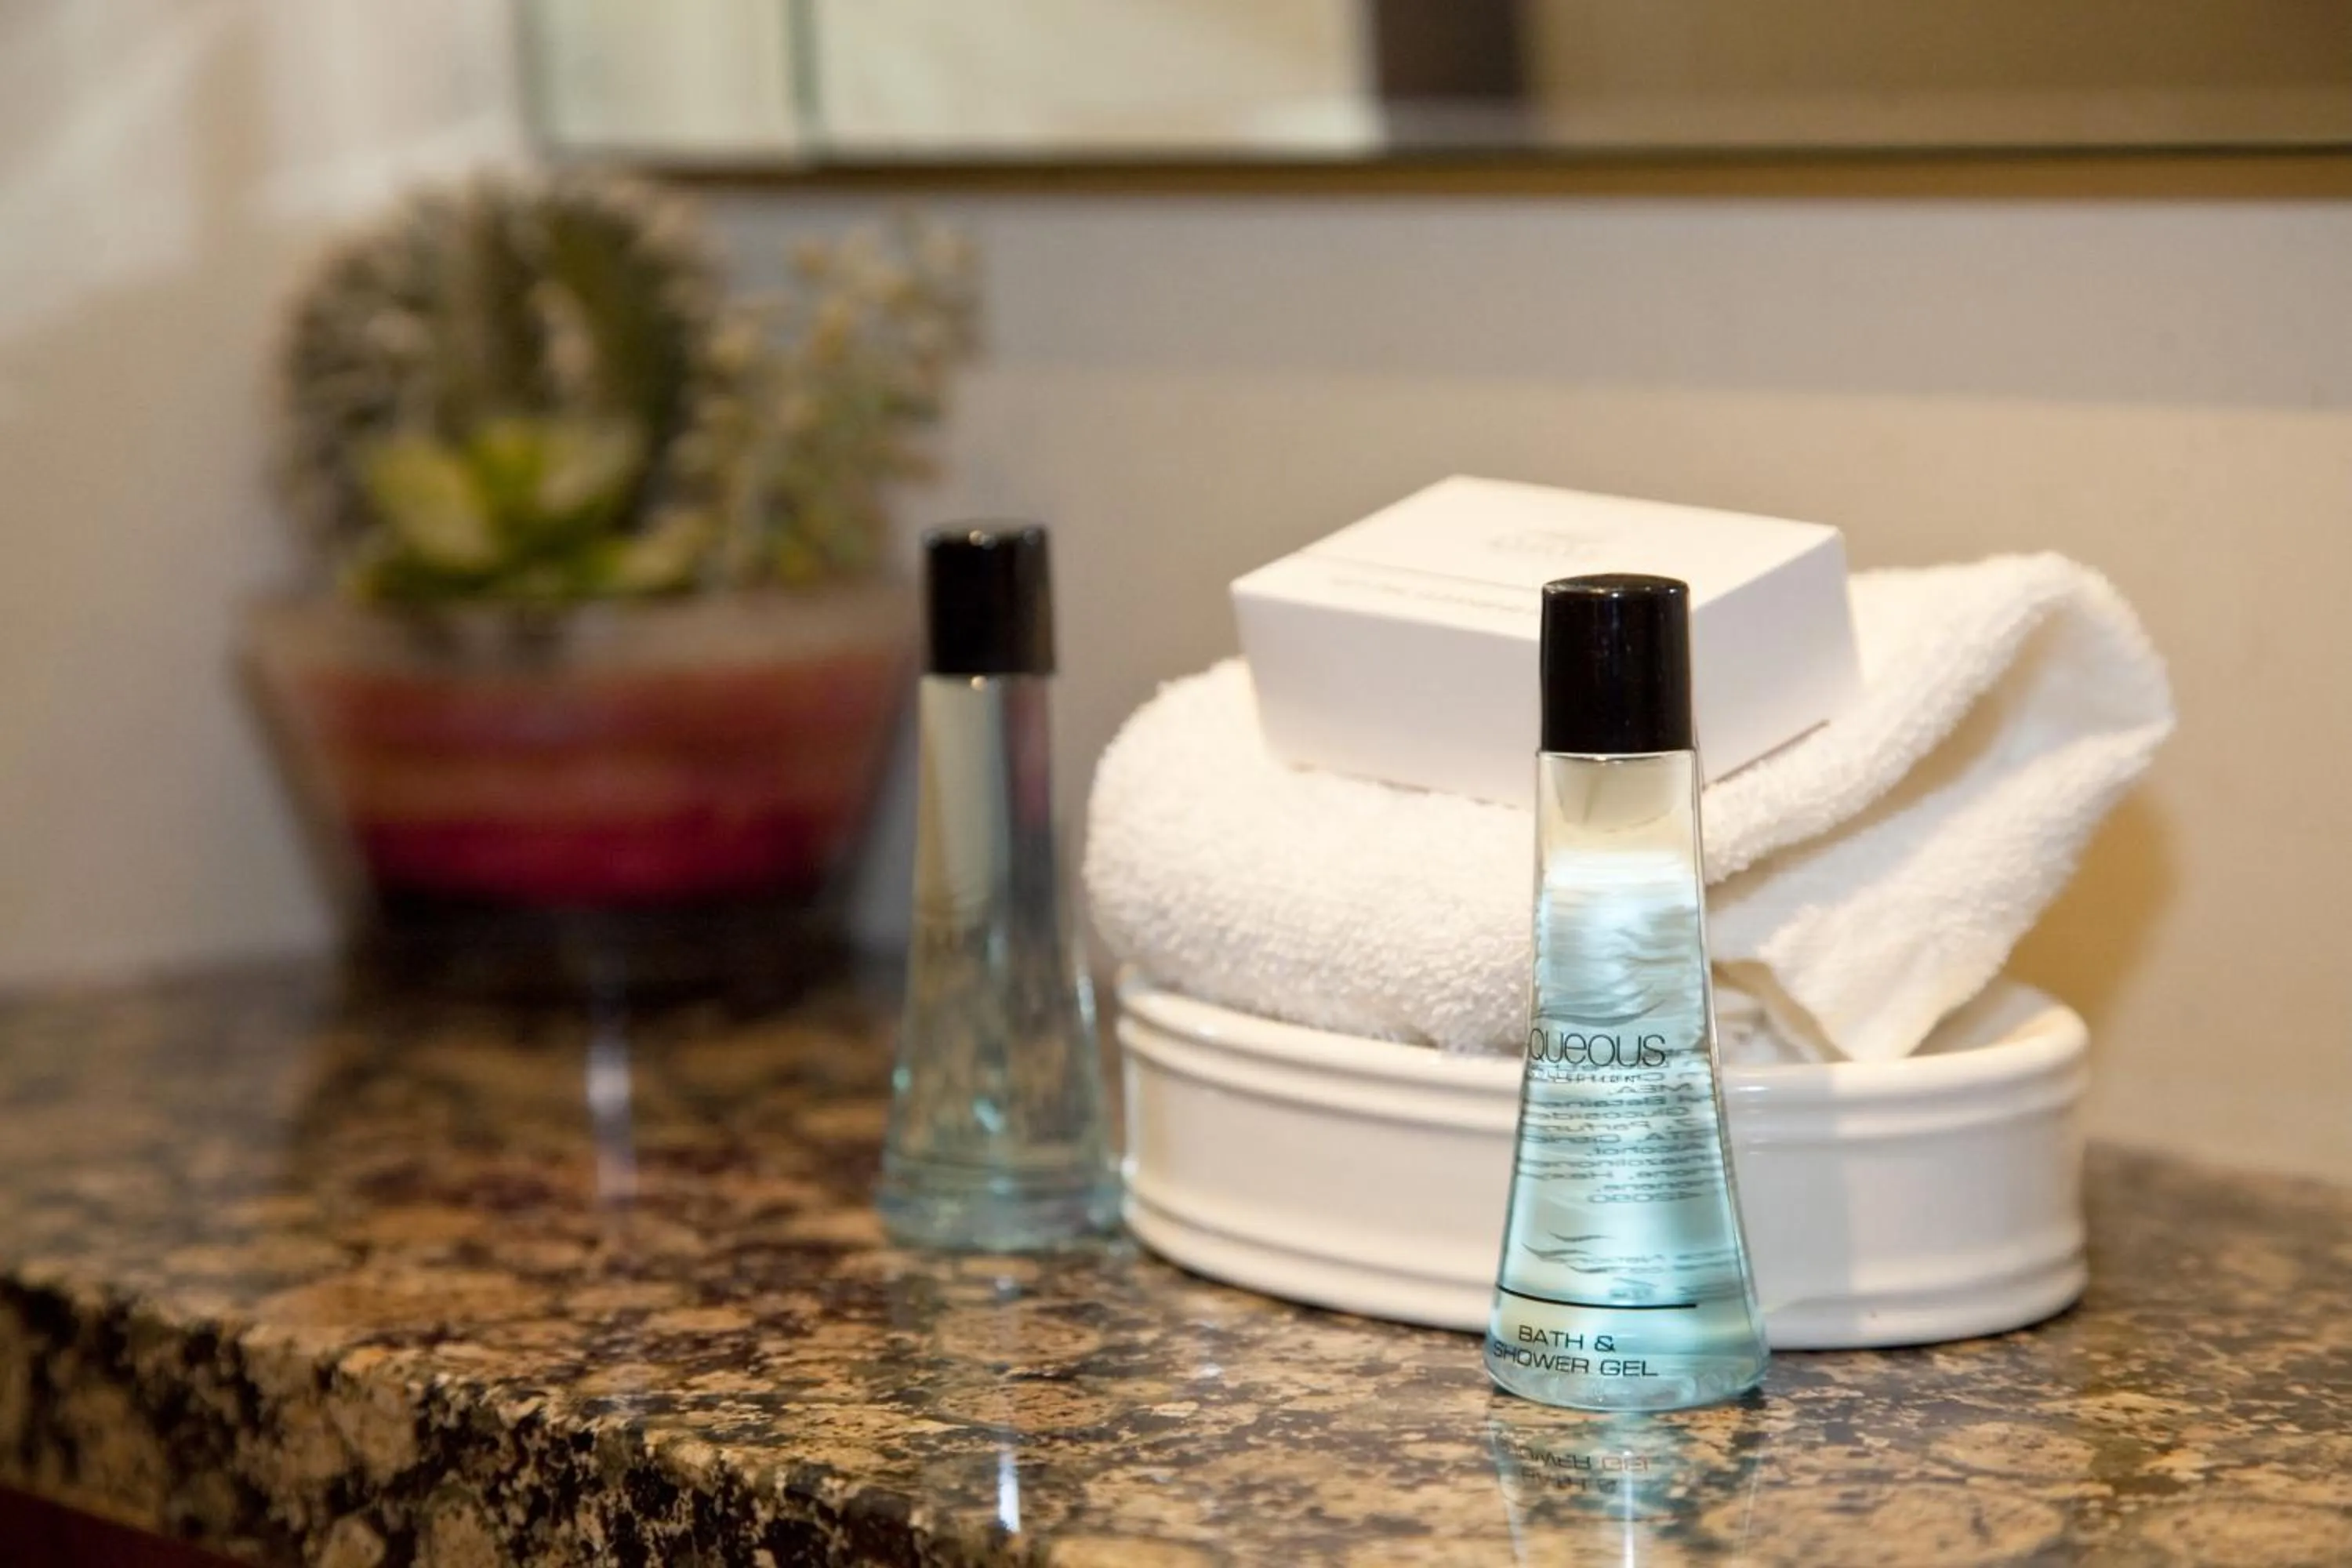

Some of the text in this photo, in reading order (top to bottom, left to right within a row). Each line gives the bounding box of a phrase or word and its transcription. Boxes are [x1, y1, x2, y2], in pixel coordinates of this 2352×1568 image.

[1519, 1324, 1615, 1352] BATH &
[1493, 1341, 1658, 1377] SHOWER GEL
